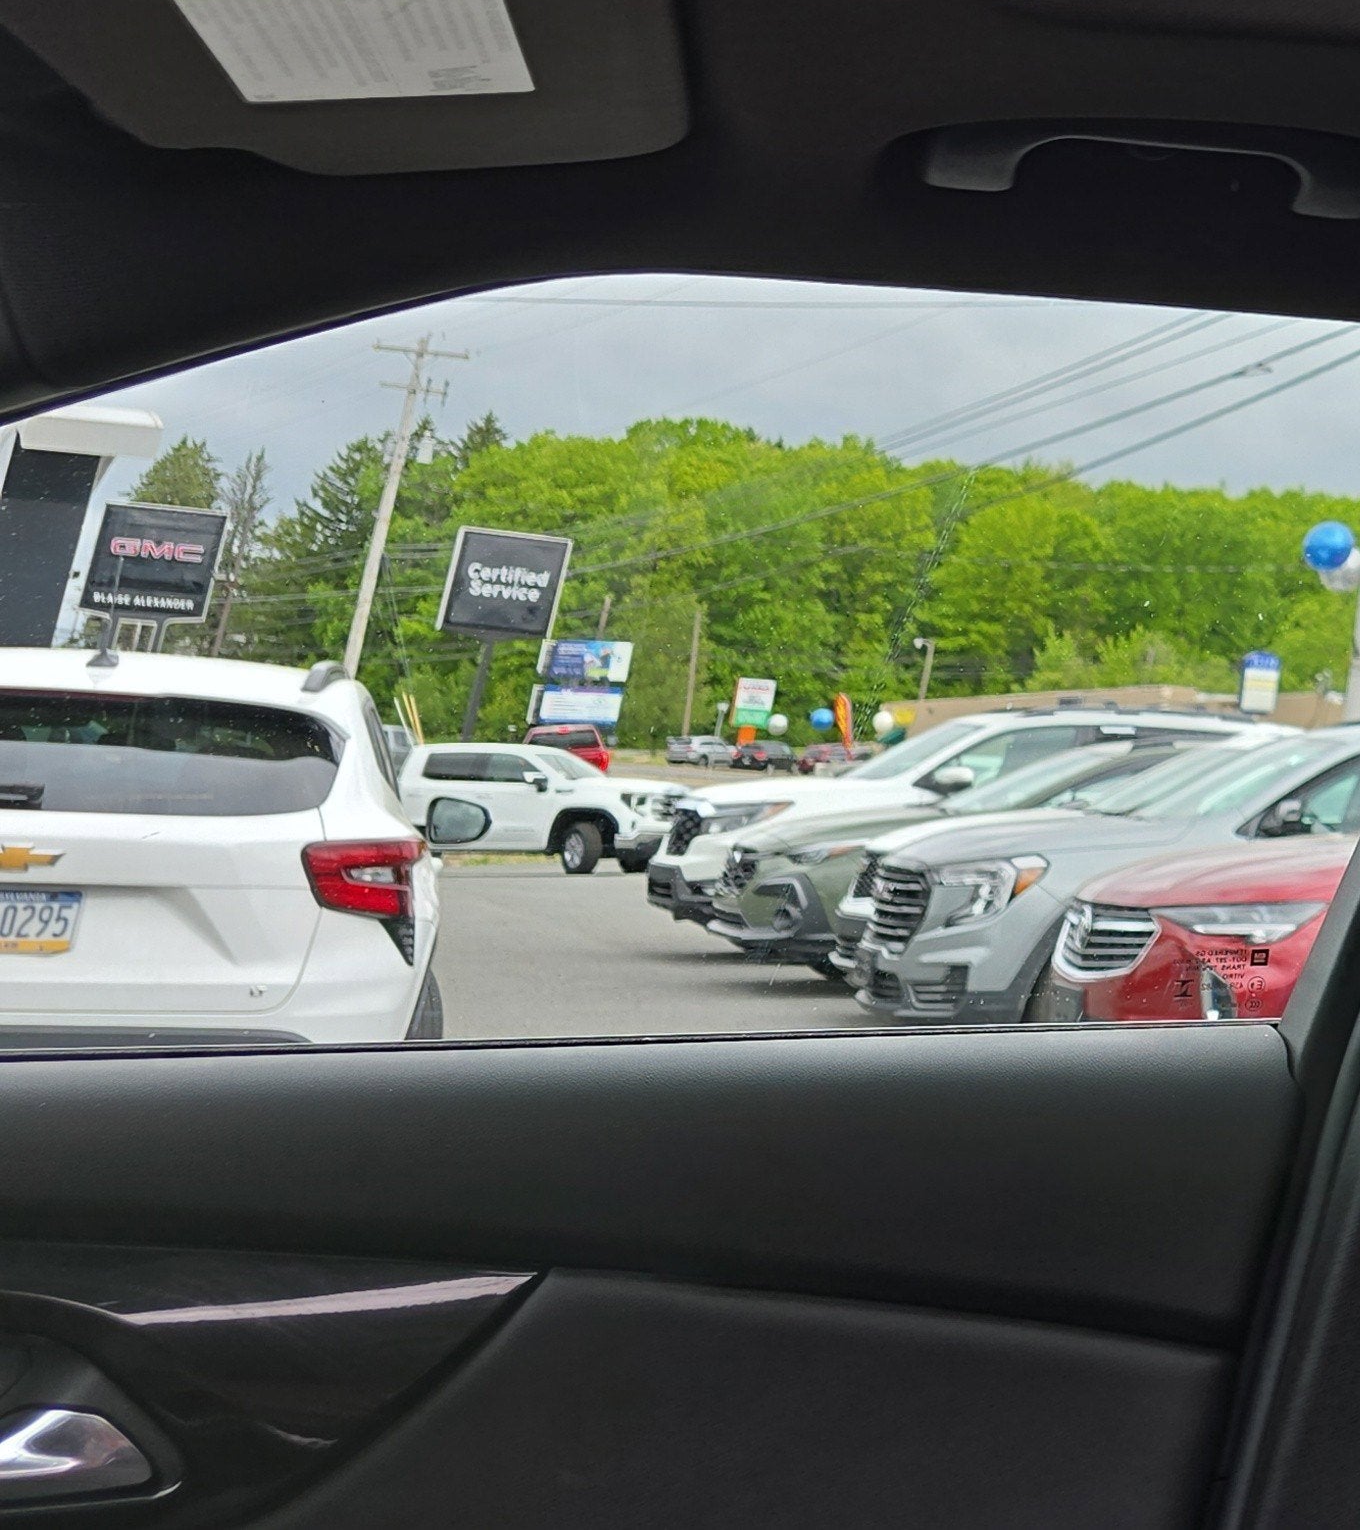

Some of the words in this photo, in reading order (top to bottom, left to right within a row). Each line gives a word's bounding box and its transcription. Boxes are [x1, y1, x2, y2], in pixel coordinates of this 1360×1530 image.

[110, 536, 205, 563] GMC
[467, 561, 551, 588] Certified
[468, 578, 541, 602] Service
[0, 904, 73, 938] 0295
